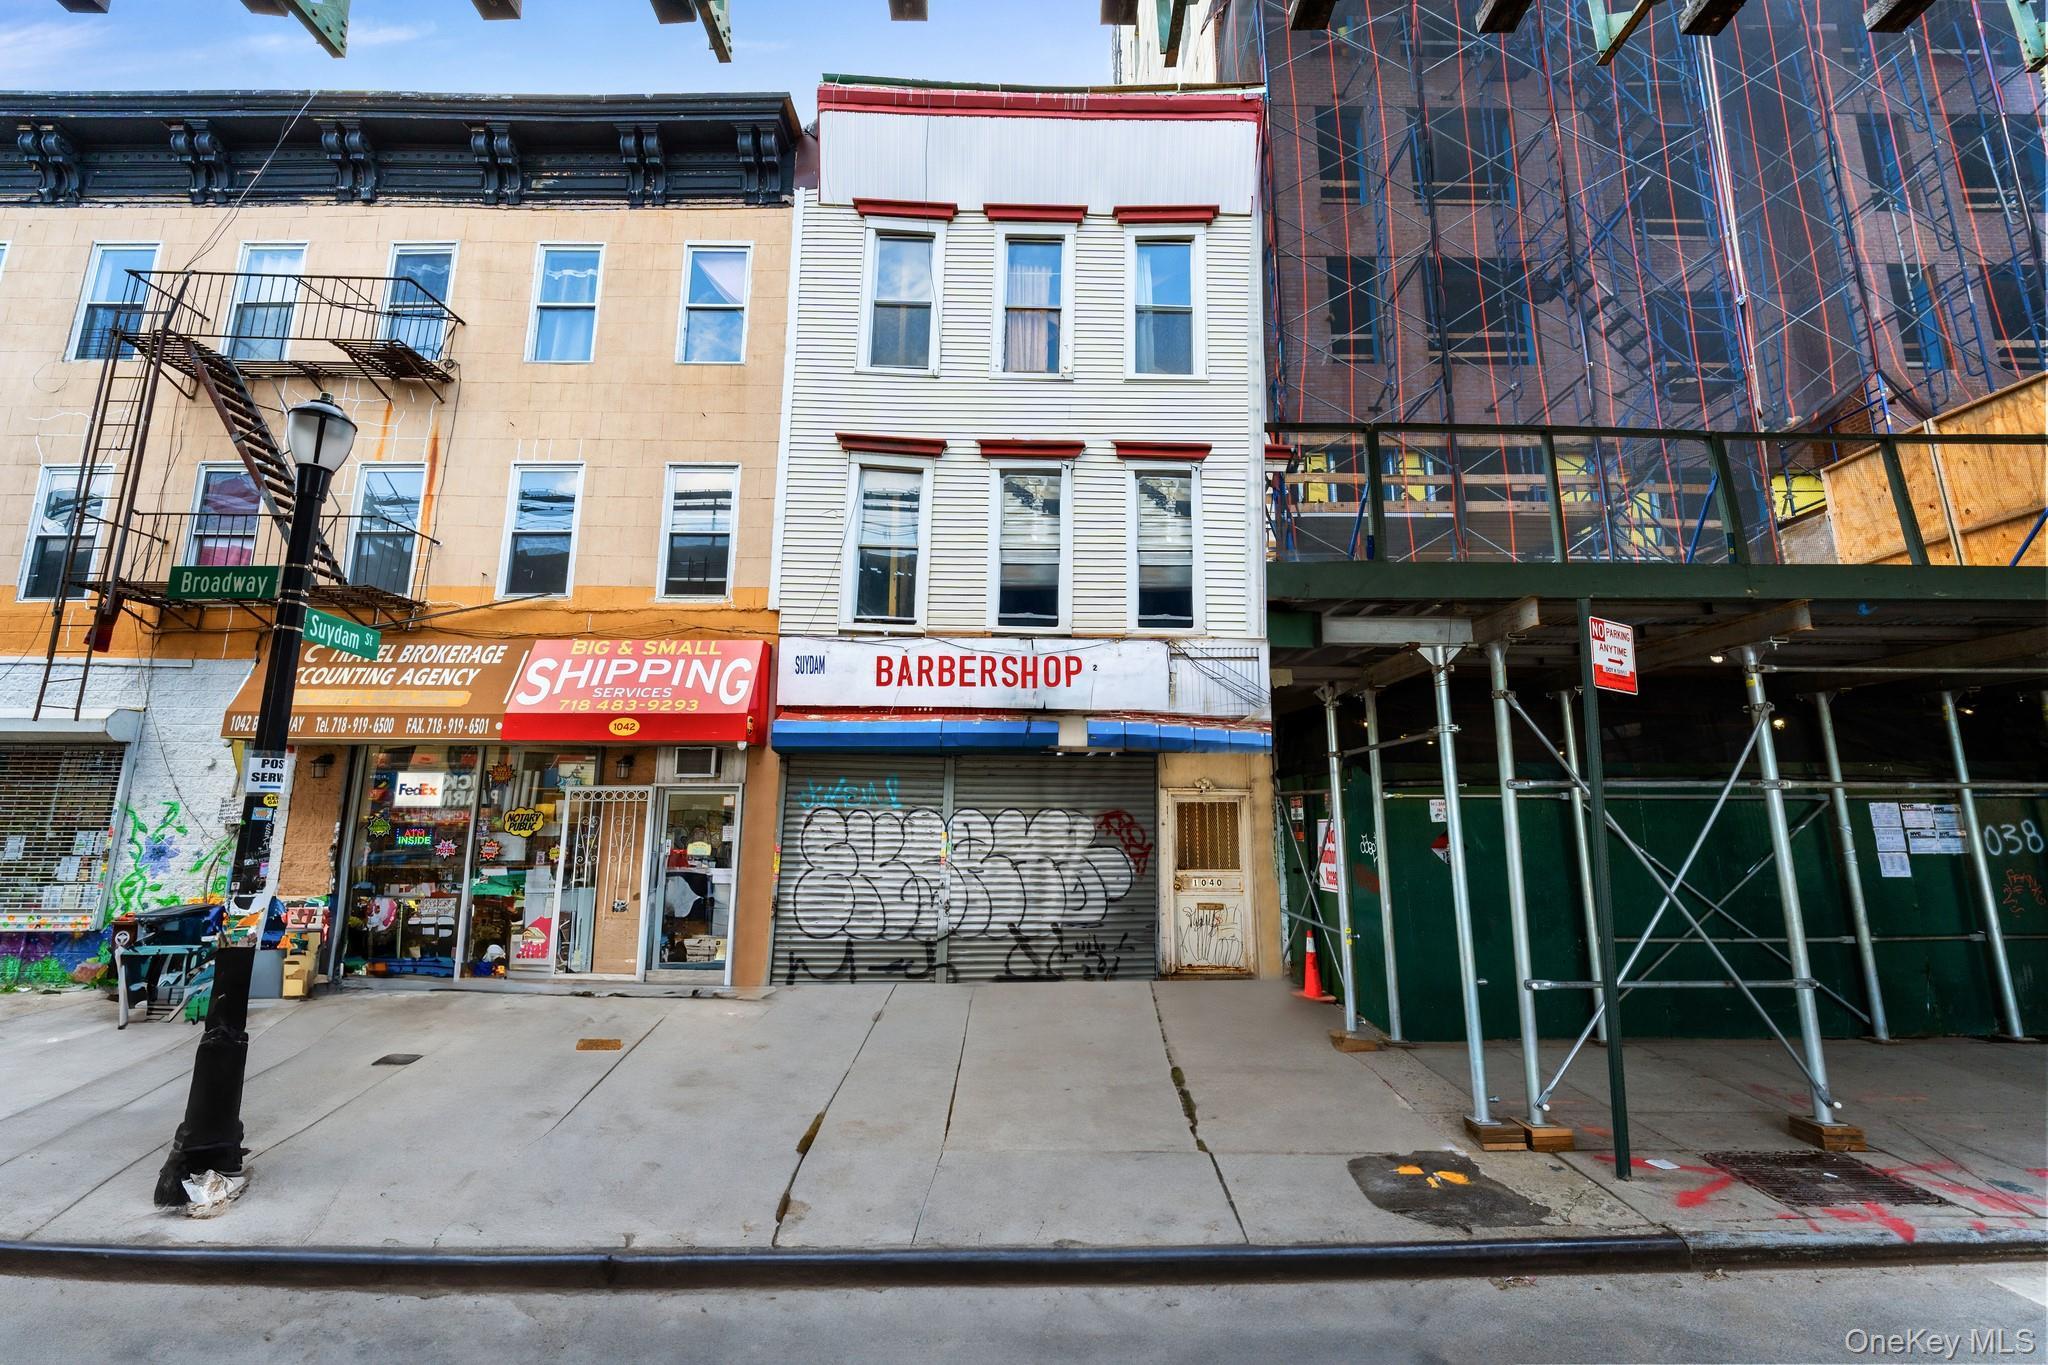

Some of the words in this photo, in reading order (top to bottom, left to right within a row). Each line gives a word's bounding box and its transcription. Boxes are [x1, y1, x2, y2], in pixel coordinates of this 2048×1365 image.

[180, 571, 269, 598] Broadway
[309, 614, 360, 650] Suydam
[364, 632, 374, 647] St
[1591, 621, 1605, 639] NO
[1605, 627, 1631, 643] PARKING
[397, 644, 508, 664] BROKERAGE
[571, 640, 610, 656] BIG
[617, 640, 634, 656] &
[641, 640, 722, 656] SMALL
[1599, 642, 1628, 657] ANYTIME
[396, 668, 482, 686] AGENCY
[794, 654, 826, 676] SUYDAM
[875, 654, 1083, 689] BARBERSHOP
[515, 657, 753, 706] SHIPPING
[591, 687, 672, 698] SERVICES
[559, 699, 591, 712] 718
[596, 699, 699, 712] 483-9293
[230, 715, 252, 732] 1042
[613, 722, 636, 732] 1042
[398, 783, 438, 796] FedEx
[506, 812, 542, 823] NOTARY
[404, 828, 425, 837] ATM
[508, 821, 537, 831] PUBLIC
[398, 836, 432, 845] INSIDE
[1984, 819, 2044, 856] 038
[1193, 879, 1222, 887] 1040
